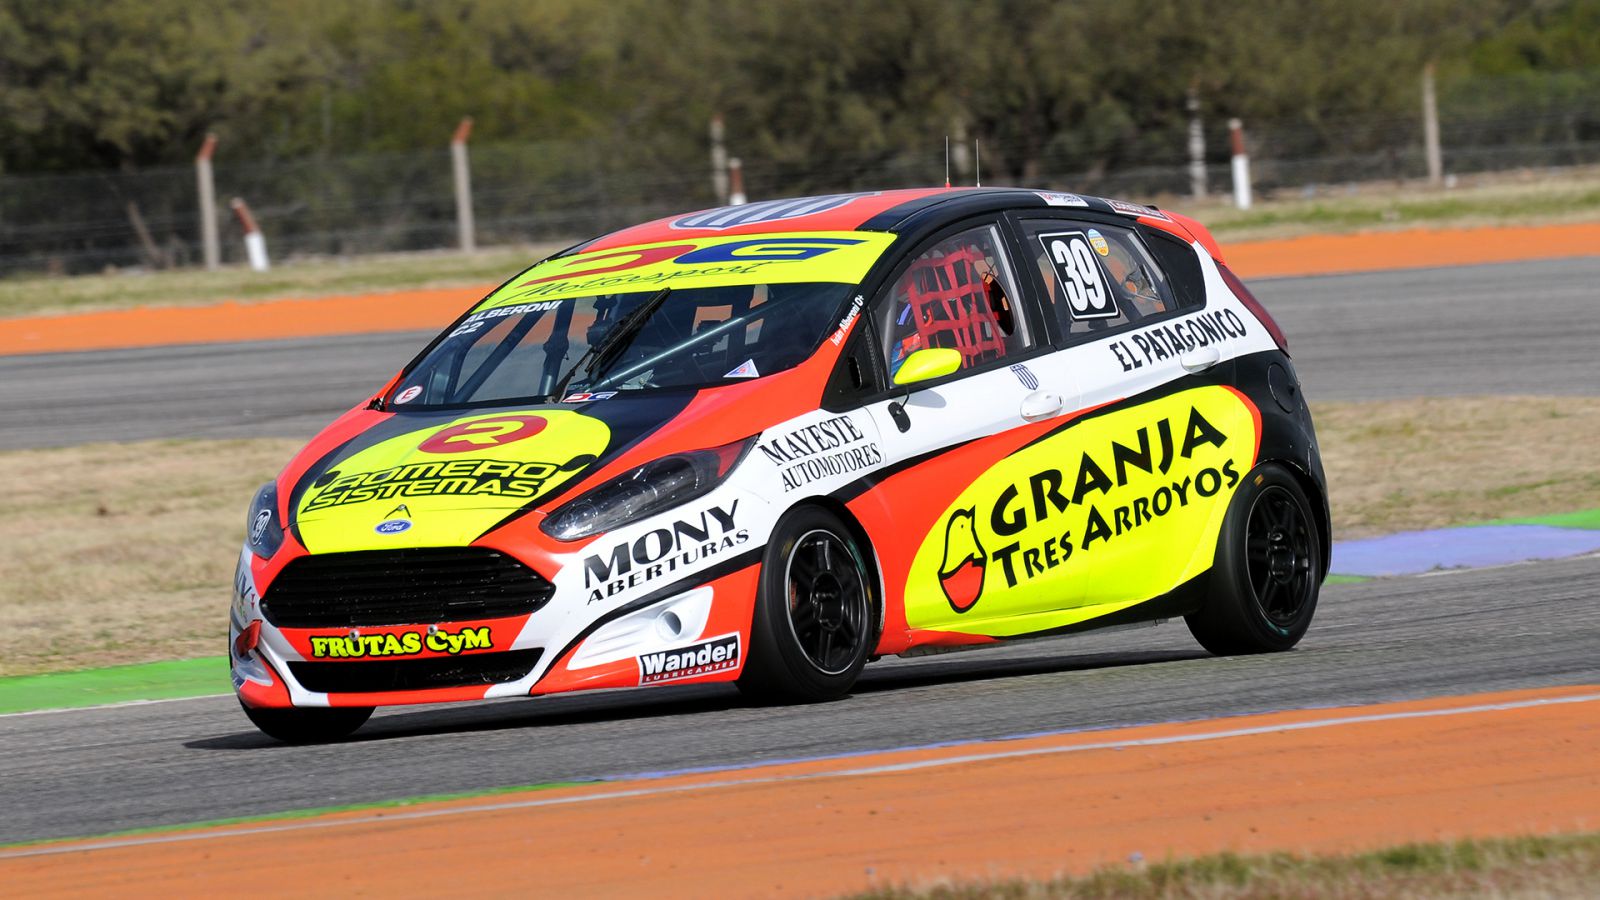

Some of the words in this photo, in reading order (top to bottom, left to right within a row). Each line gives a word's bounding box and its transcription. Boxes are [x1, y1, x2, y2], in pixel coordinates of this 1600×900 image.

[500, 259, 797, 304] Motorsport
[1051, 238, 1106, 312] 39
[448, 321, 485, 338] C2
[460, 300, 563, 326] ALBERONI
[839, 302, 861, 333] Alberoni
[1109, 340, 1143, 373] EL
[1131, 308, 1247, 366] PATAGONICO
[758, 415, 864, 467] MAYESTE
[320, 459, 564, 498] ROMERO
[780, 442, 882, 493] AUTOMOTORES
[990, 405, 1228, 537] GRANJA
[302, 476, 542, 514] SISTEMAS
[583, 498, 740, 589] MONY
[586, 528, 750, 606] ABERTURAS
[310, 632, 422, 658] FRUTAS
[426, 627, 492, 655] CyM
[642, 642, 737, 675] Wander
[645, 660, 736, 682] LUBRICANTES
